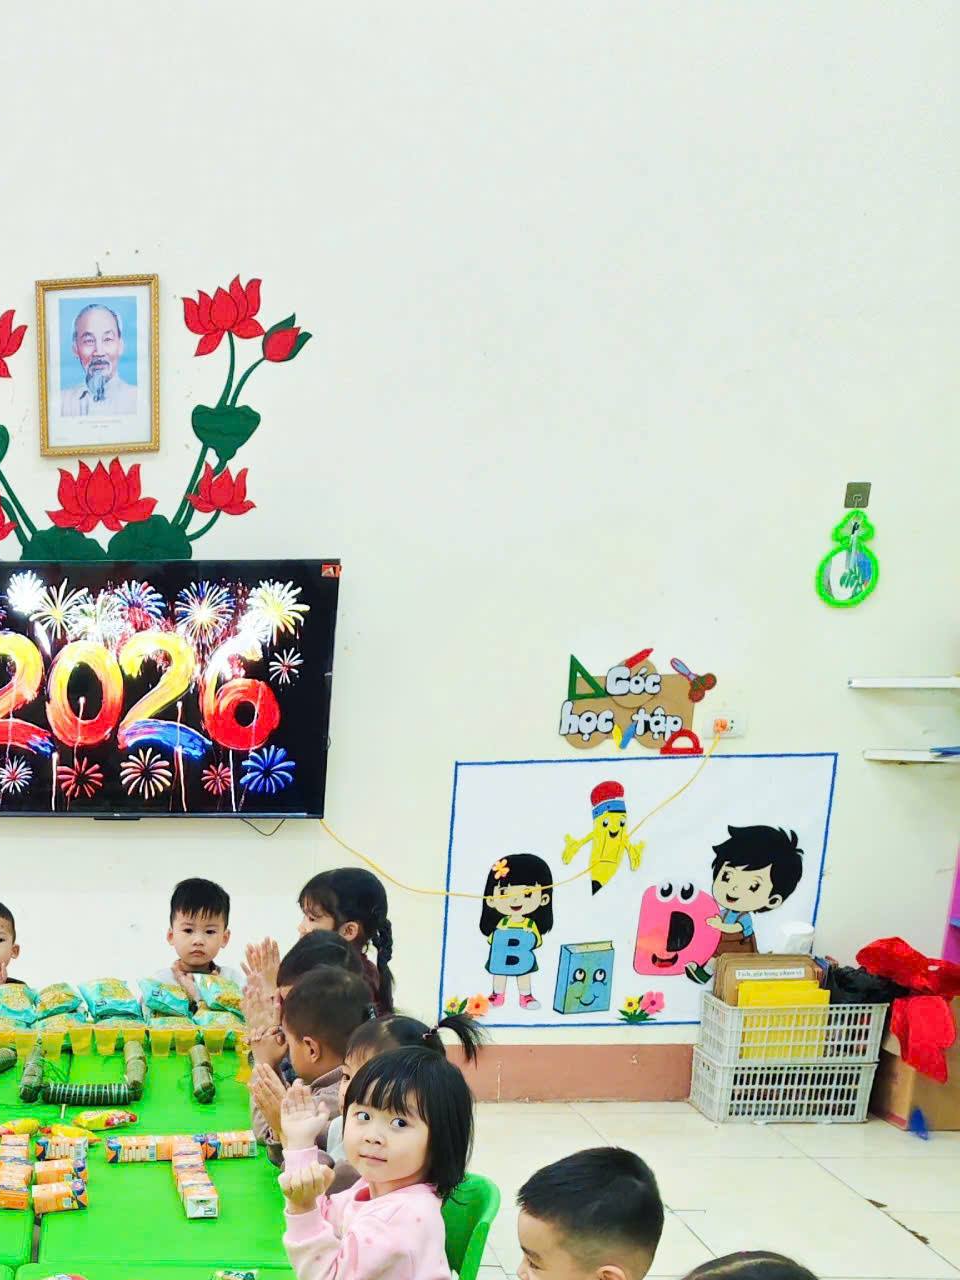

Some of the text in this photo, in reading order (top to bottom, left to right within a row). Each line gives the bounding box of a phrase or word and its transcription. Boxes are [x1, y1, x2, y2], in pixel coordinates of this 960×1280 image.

[606, 665, 661, 696] Góc
[559, 699, 683, 742] học tập
[488, 927, 538, 976] B
